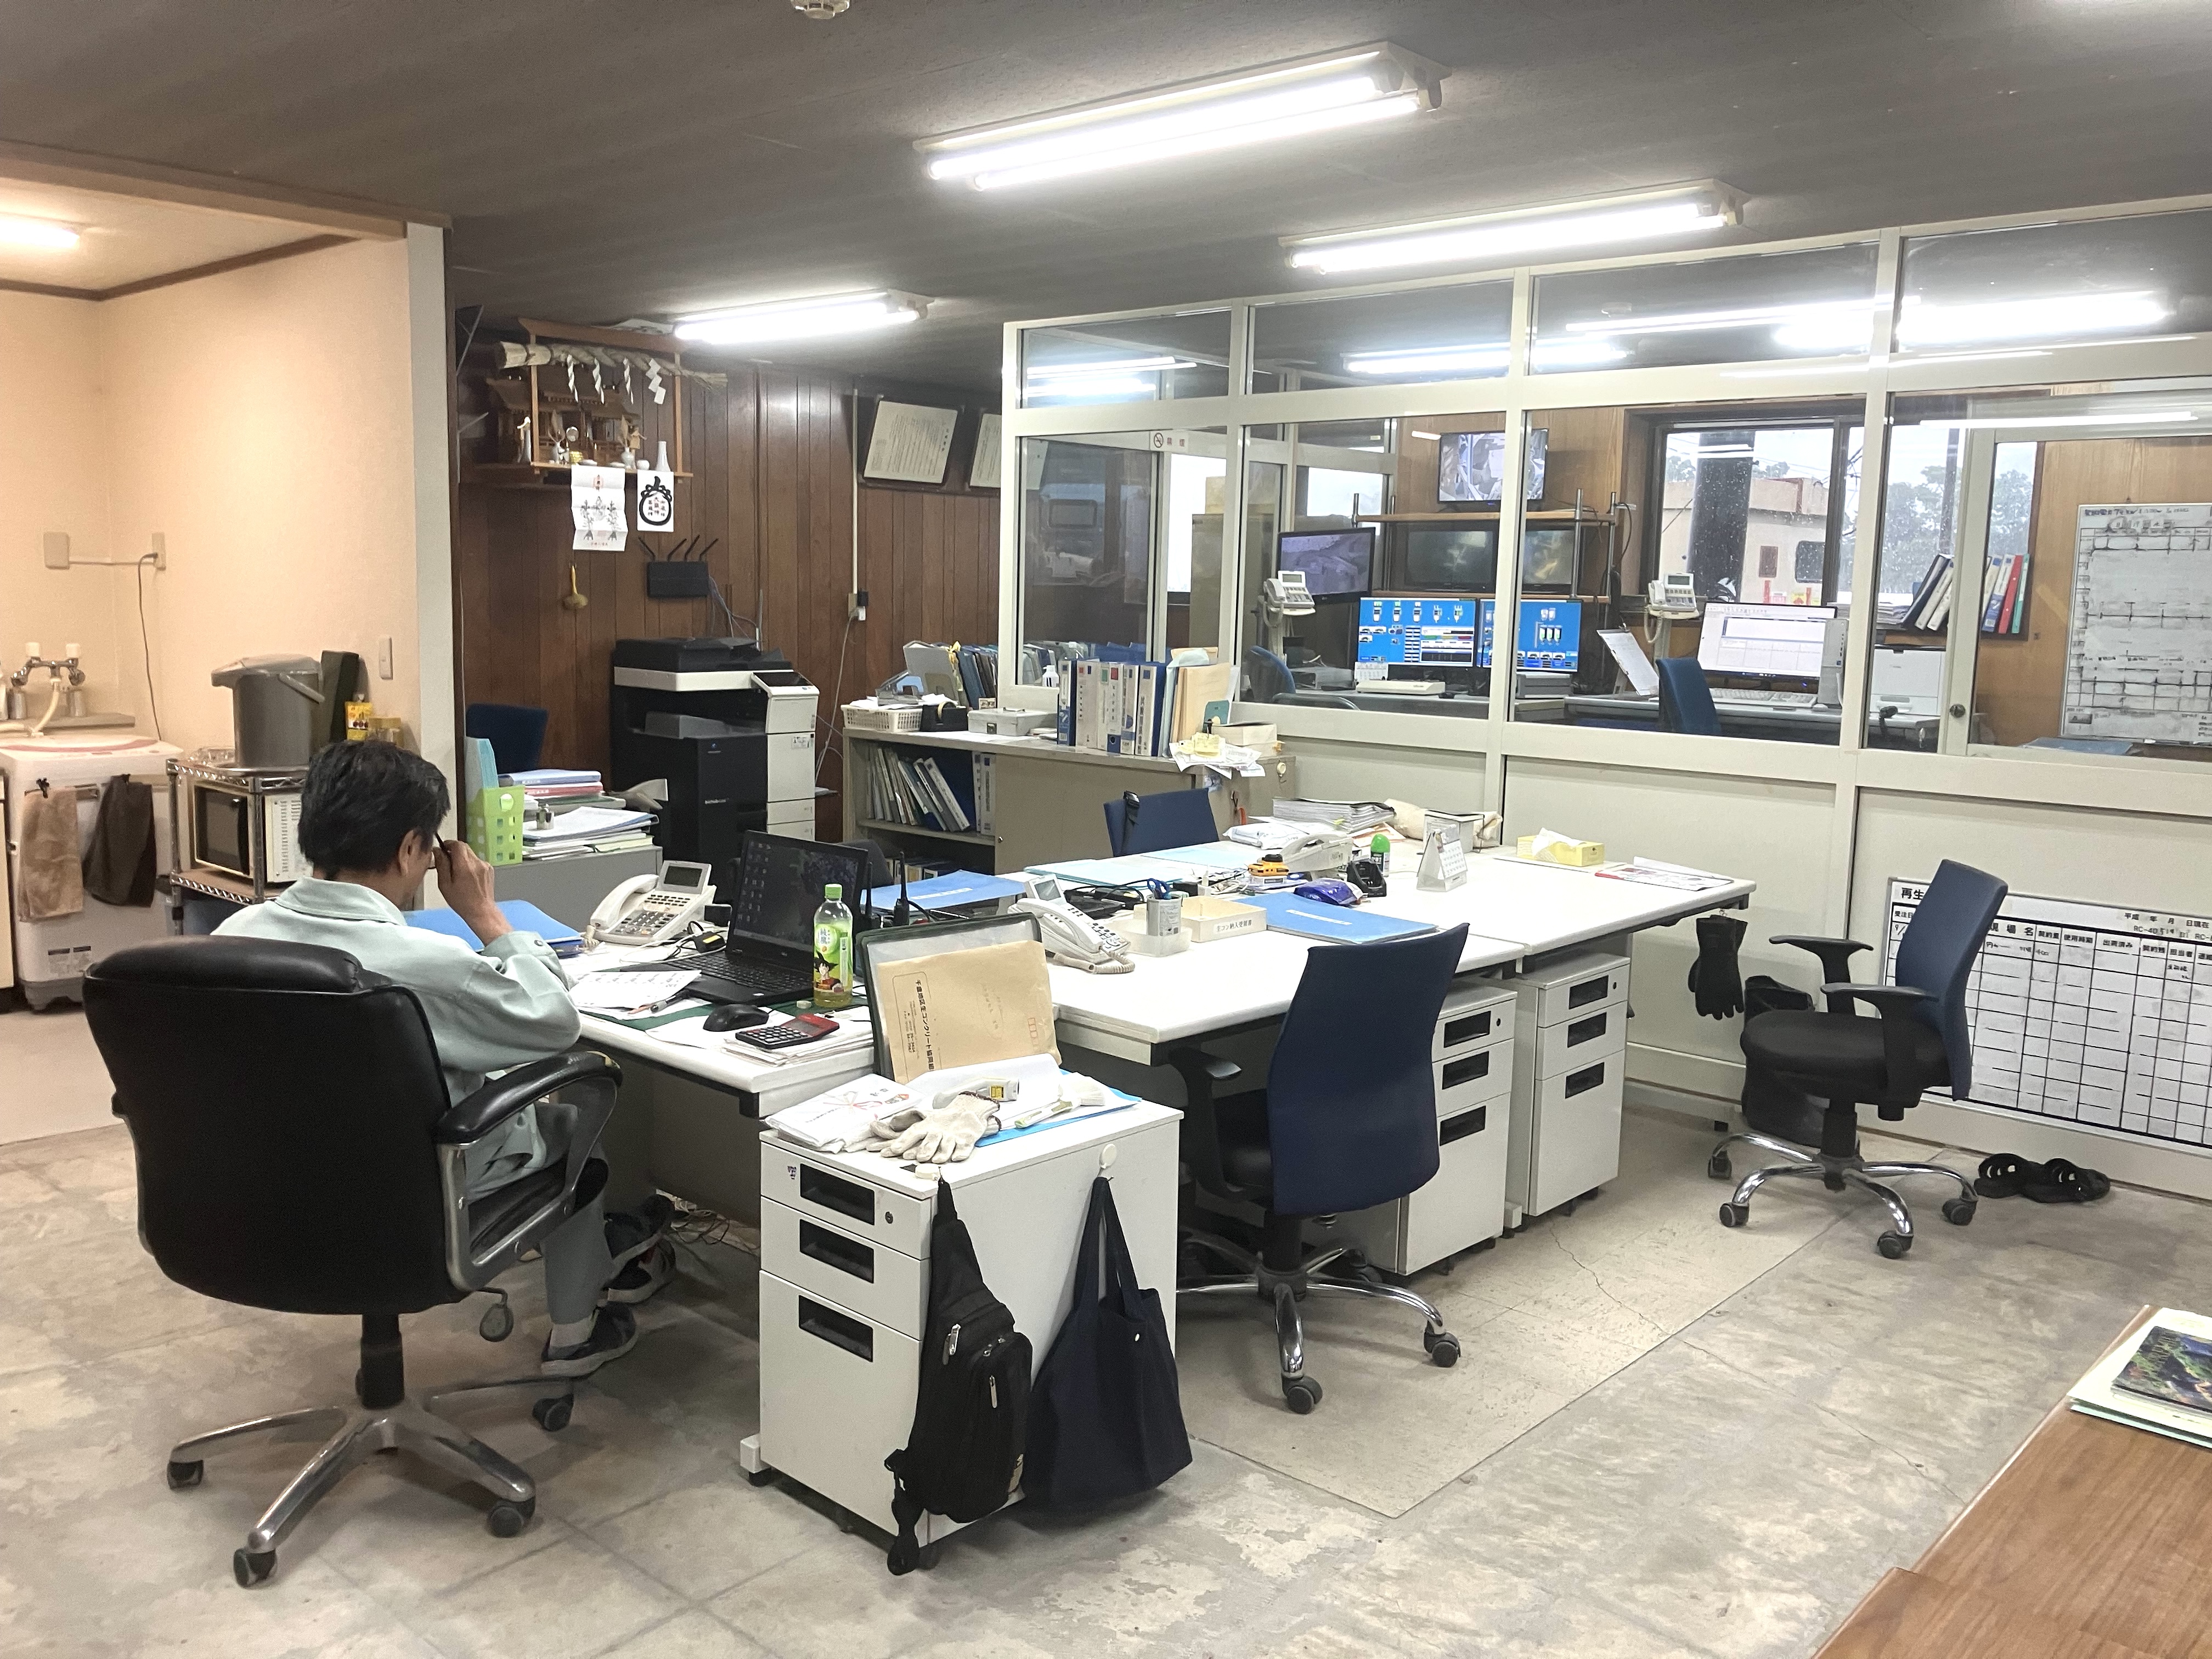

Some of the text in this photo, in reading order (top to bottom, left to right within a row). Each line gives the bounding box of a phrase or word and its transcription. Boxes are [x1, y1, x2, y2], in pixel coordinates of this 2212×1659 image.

[1901, 887, 1925, 900] 再生
[2194, 933, 2212, 941] RC-
[915, 979, 935, 1070] 千歳地区生コンクリート協同組
